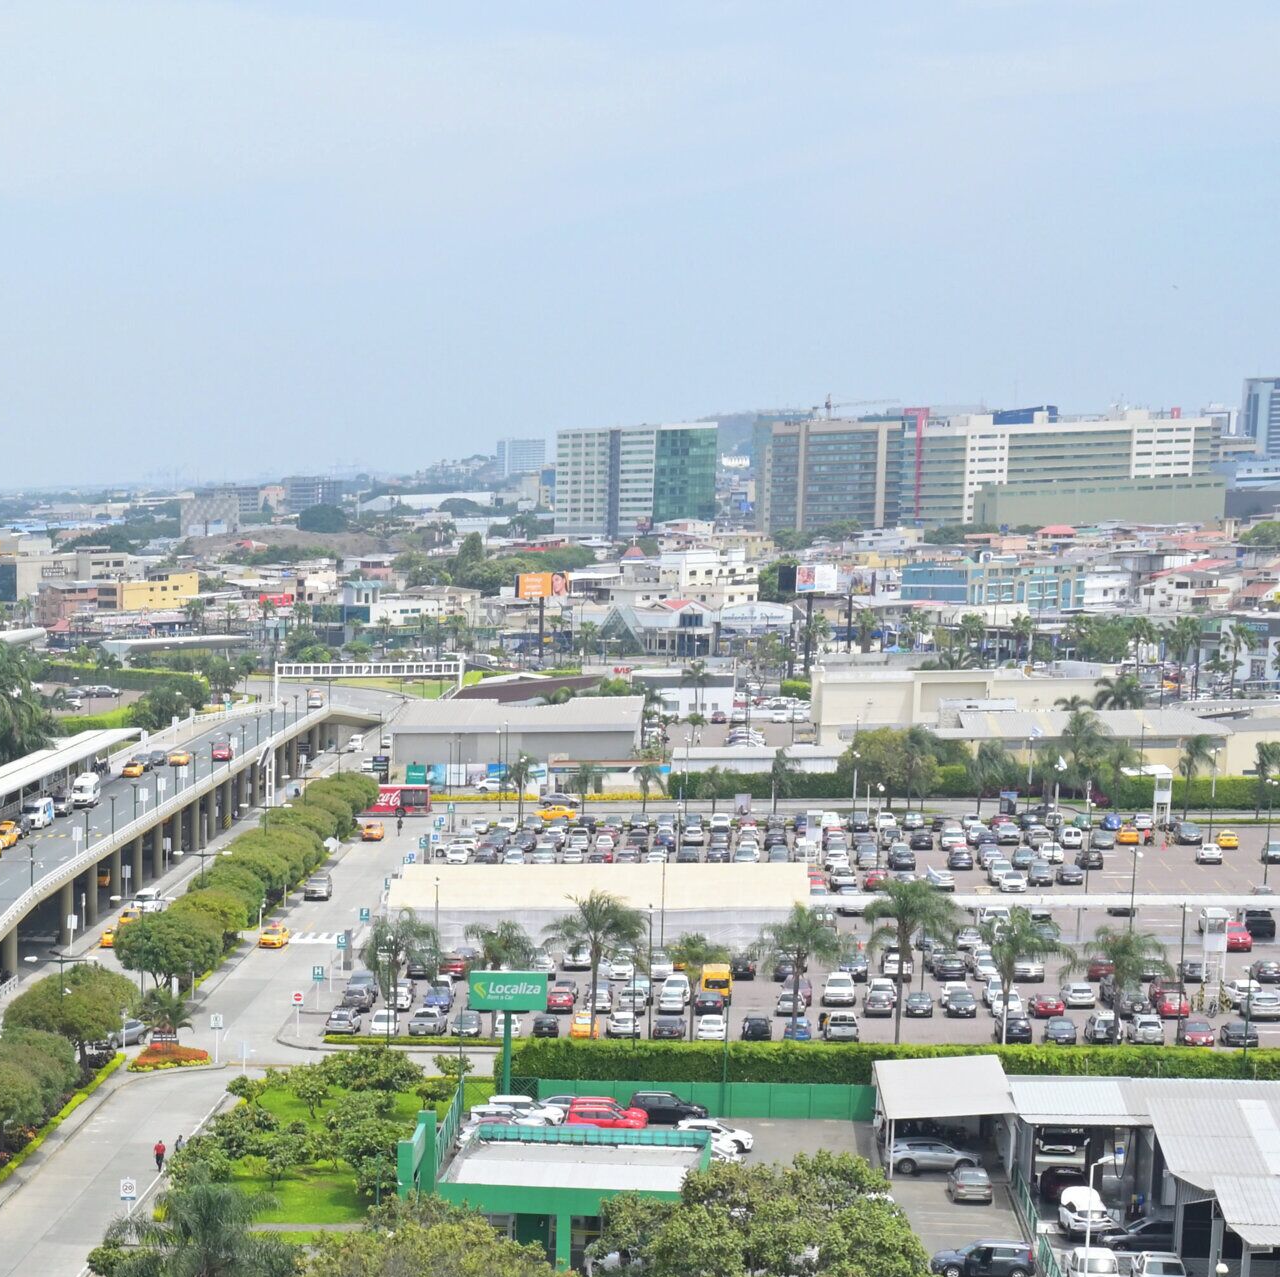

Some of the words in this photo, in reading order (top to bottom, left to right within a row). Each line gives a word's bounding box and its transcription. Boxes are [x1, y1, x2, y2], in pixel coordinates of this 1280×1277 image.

[338, 935, 346, 944] G
[314, 966, 321, 975] H
[488, 982, 541, 994] Localiza
